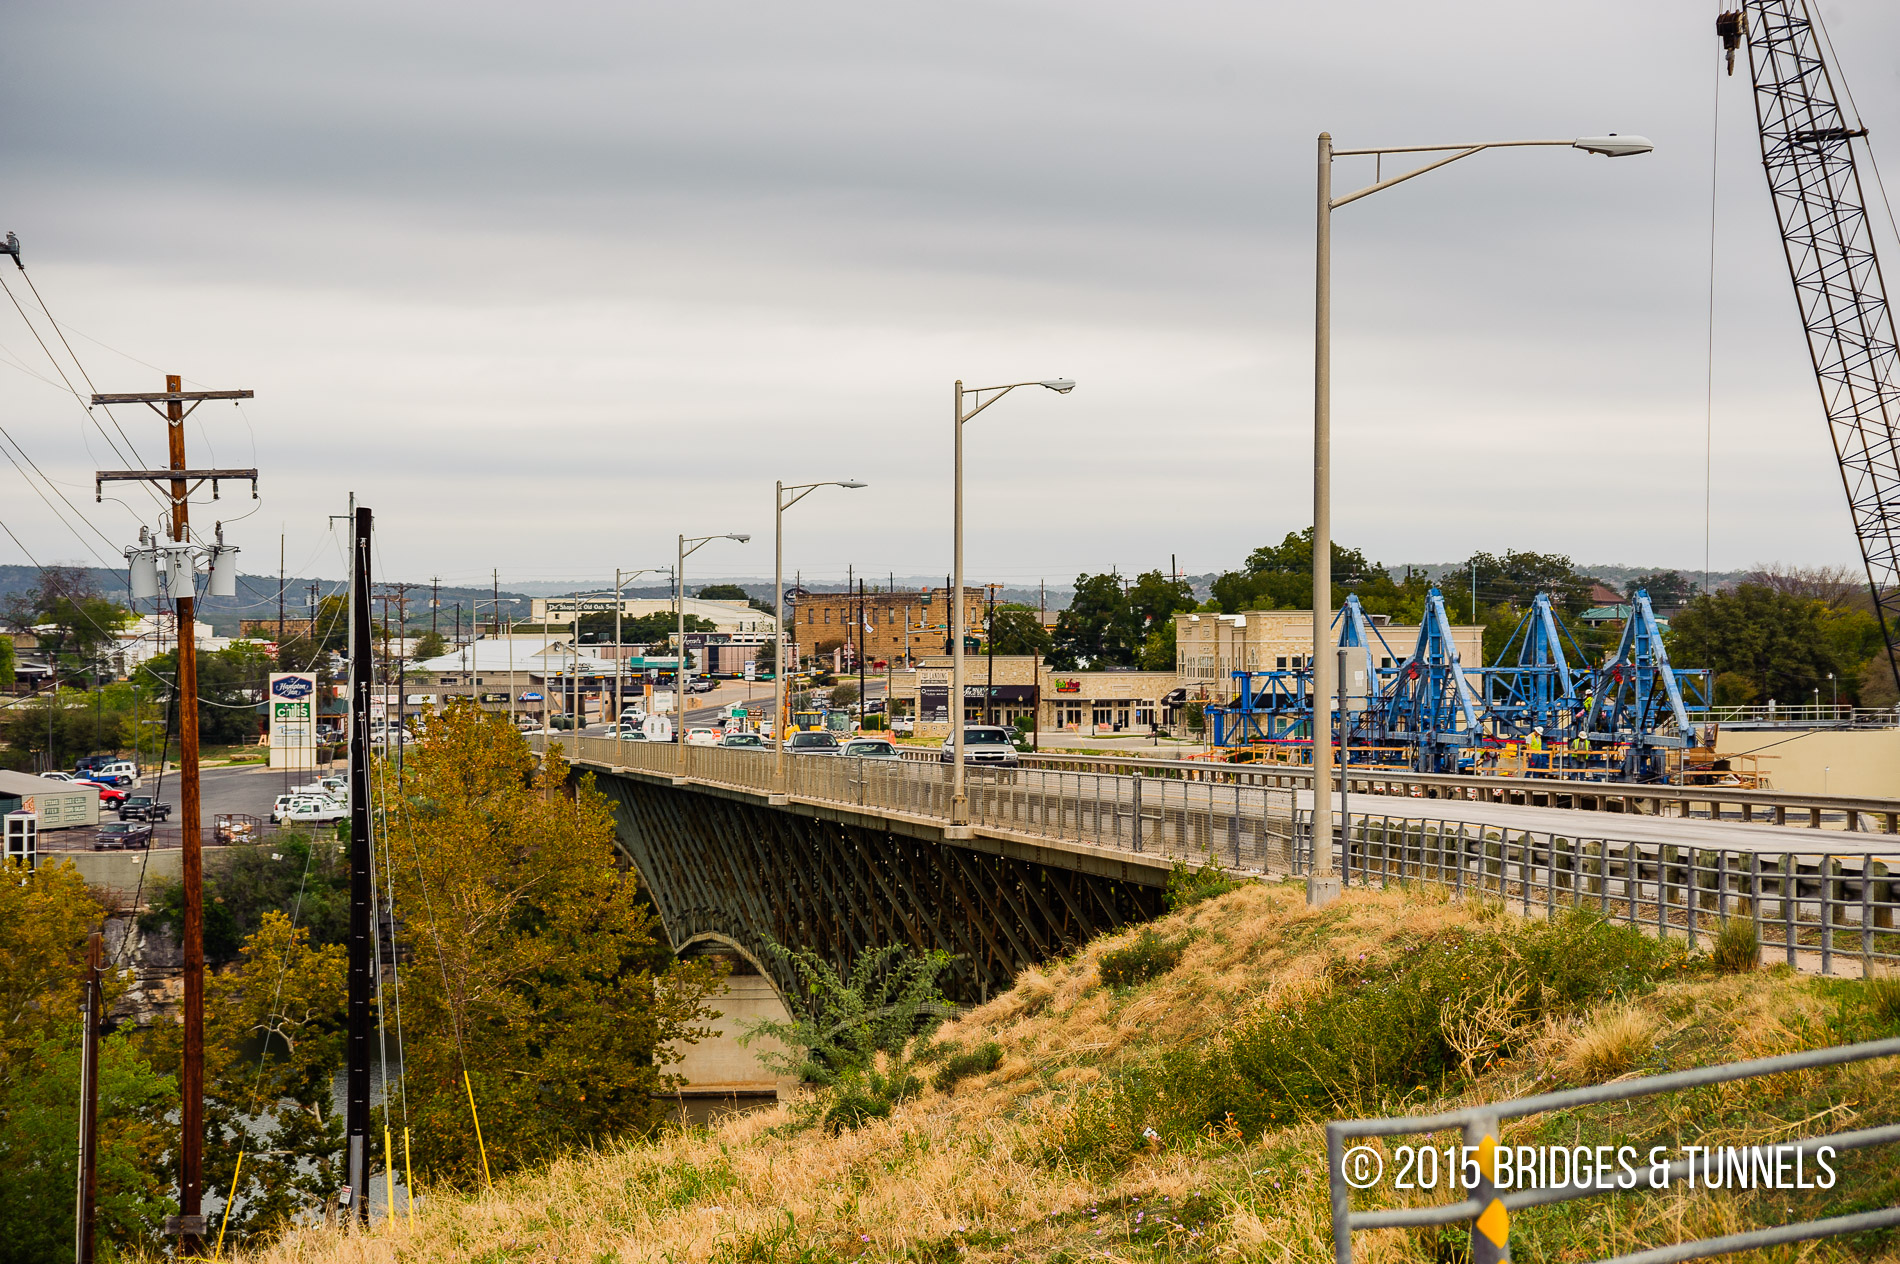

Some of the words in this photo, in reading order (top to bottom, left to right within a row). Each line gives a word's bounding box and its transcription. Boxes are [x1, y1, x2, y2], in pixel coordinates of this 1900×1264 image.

[606, 603, 624, 611] Sque
[276, 683, 309, 692] Hampton
[284, 689, 301, 697] Inn
